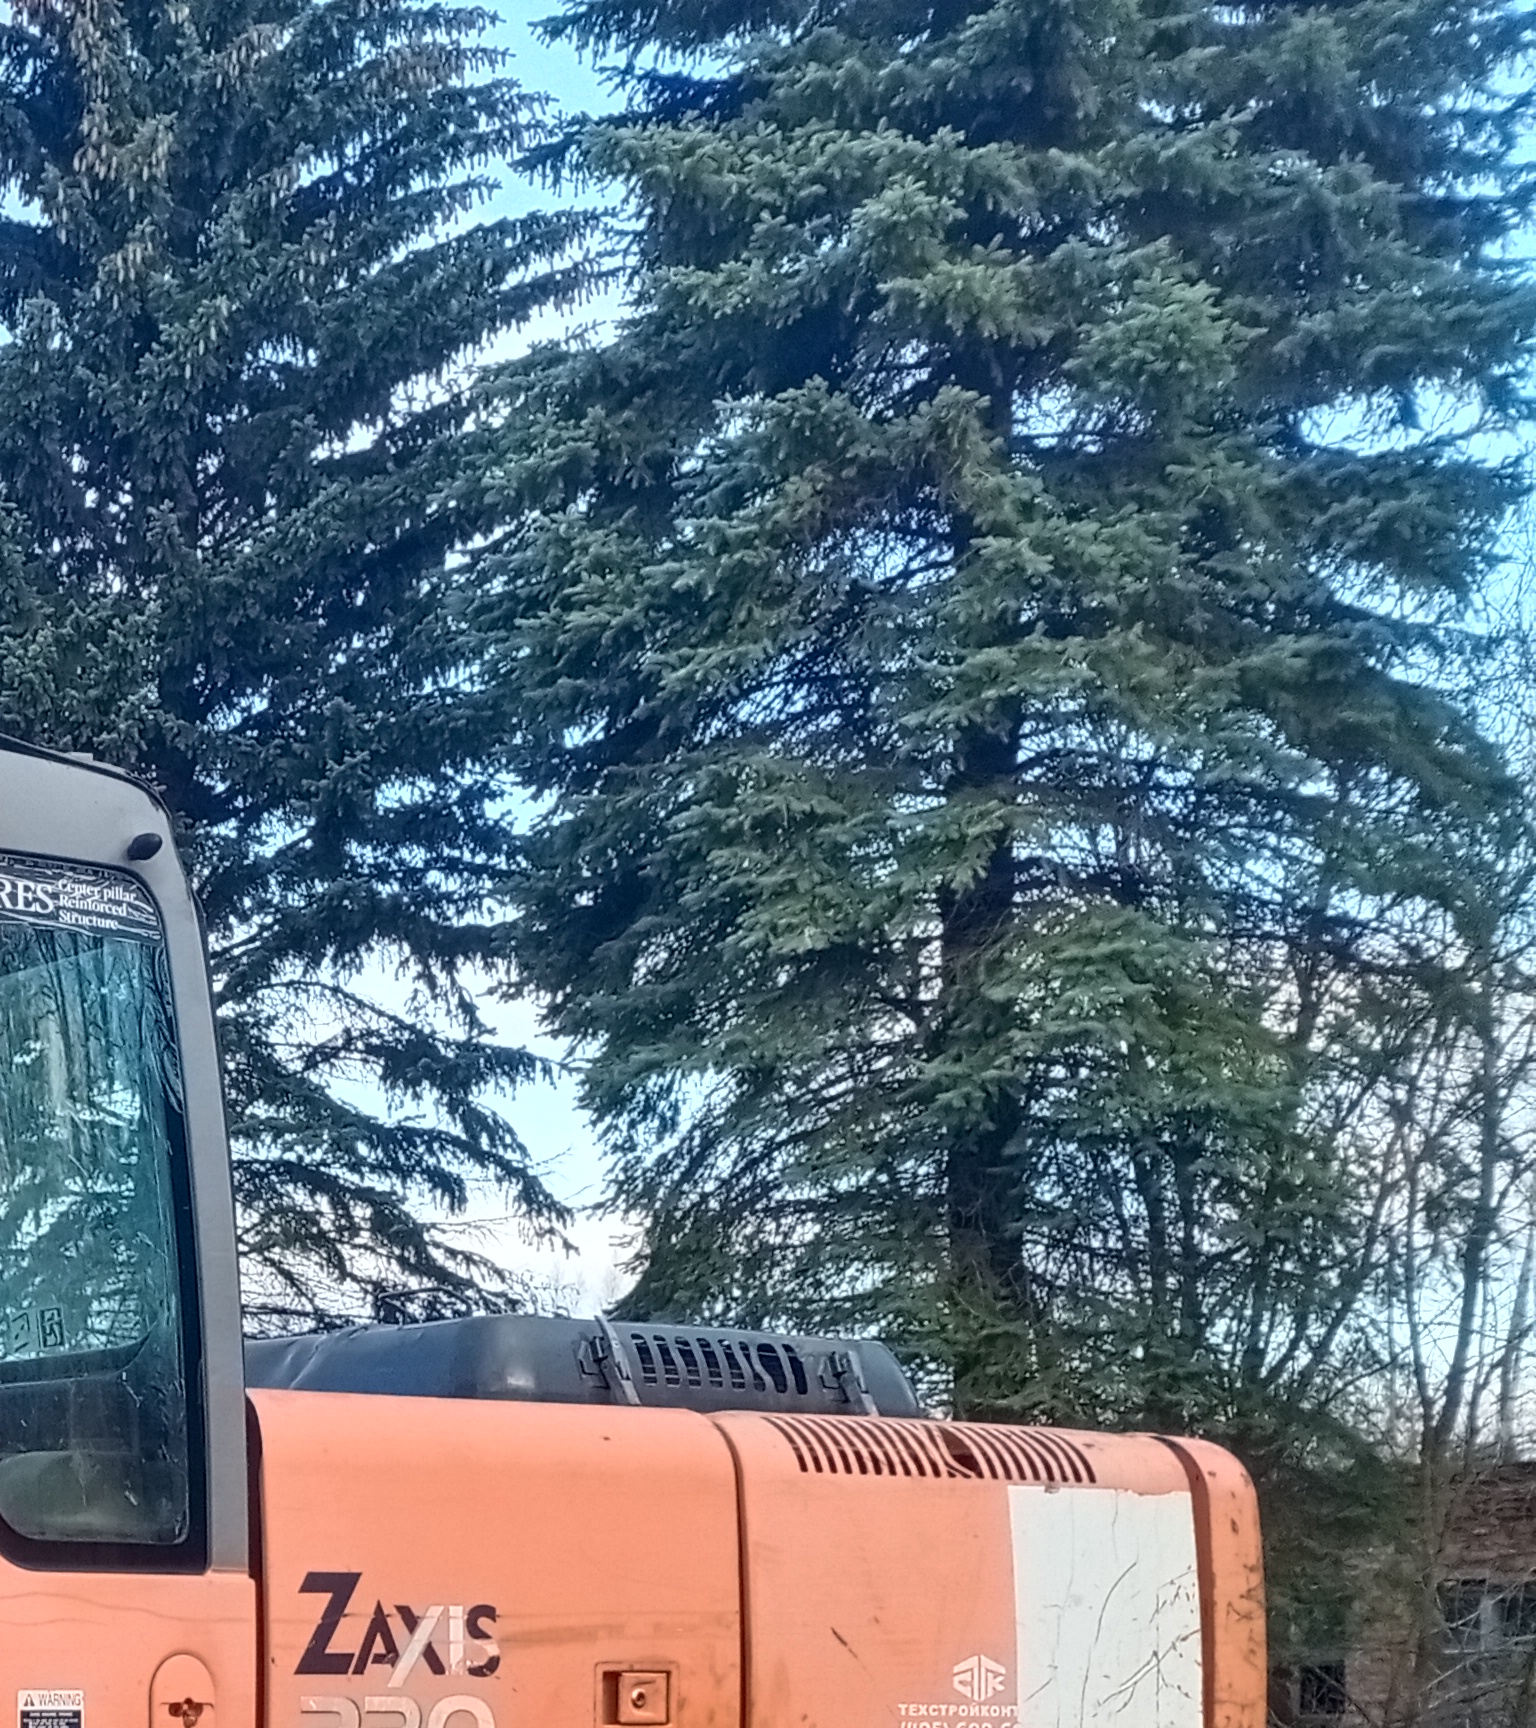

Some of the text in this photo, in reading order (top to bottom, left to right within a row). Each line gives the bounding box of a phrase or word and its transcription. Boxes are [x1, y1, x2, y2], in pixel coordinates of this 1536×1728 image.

[58, 878, 136, 903] Center pillar
[59, 894, 127, 916] Reinforced
[59, 909, 118, 930] Structure
[294, 1571, 501, 1688] ZAXIS
[38, 1693, 81, 1706] WARNING
[898, 1702, 1018, 1717] ТЕХСТРОЙКОНТ
